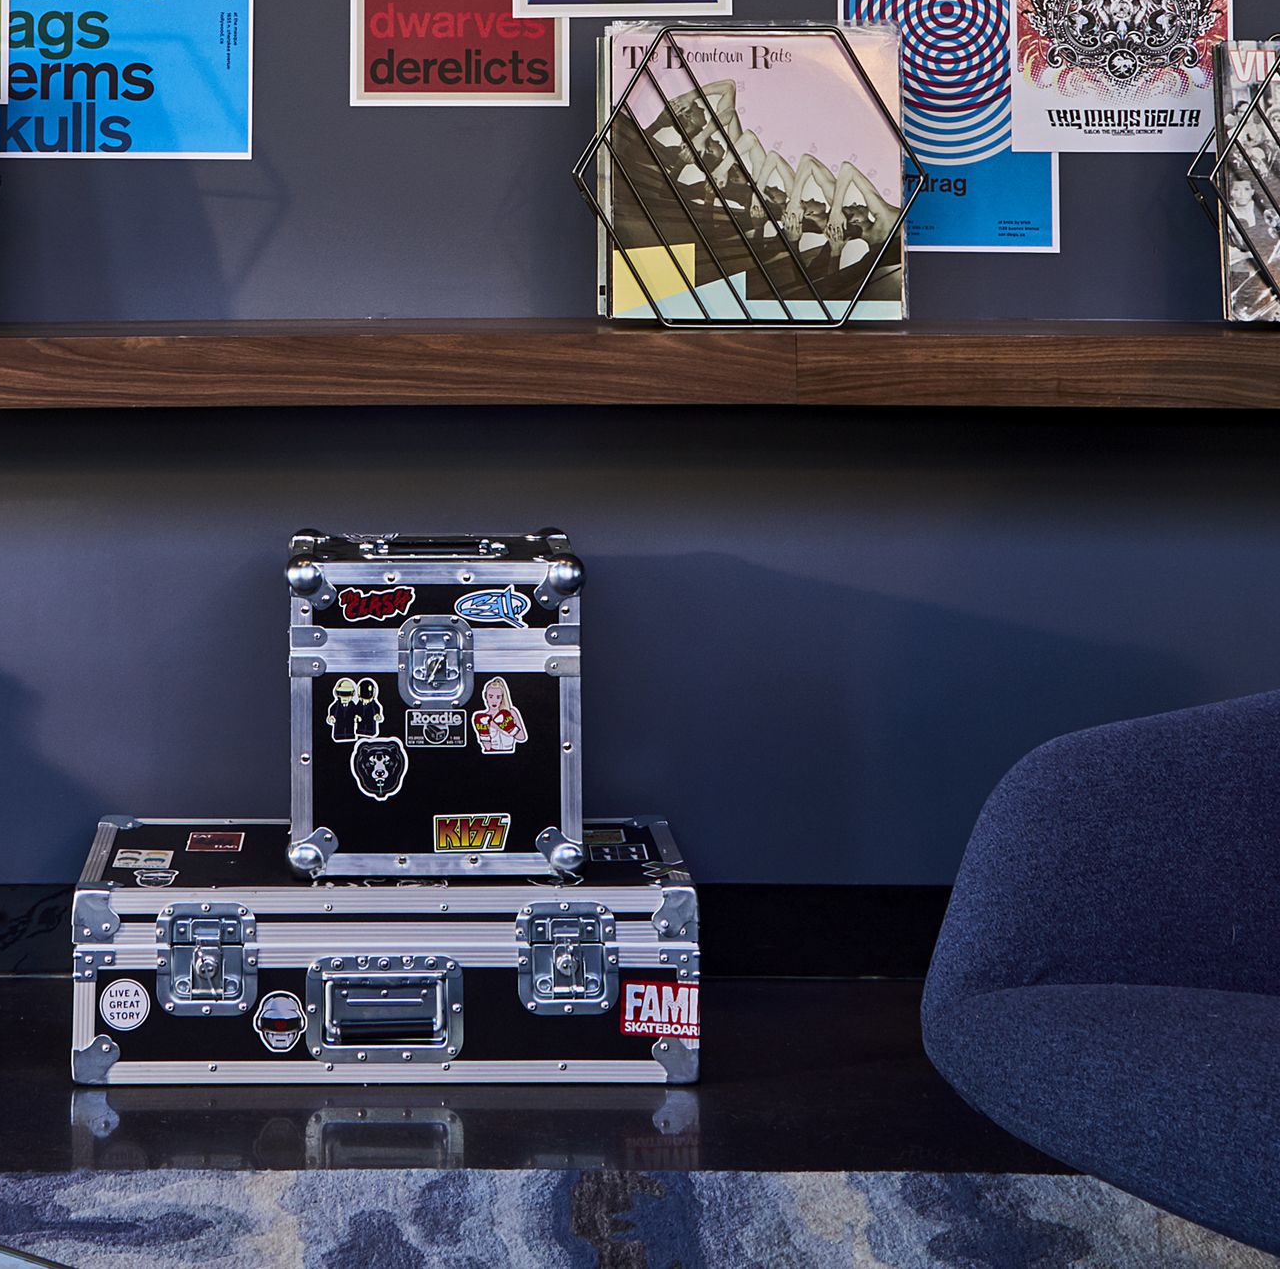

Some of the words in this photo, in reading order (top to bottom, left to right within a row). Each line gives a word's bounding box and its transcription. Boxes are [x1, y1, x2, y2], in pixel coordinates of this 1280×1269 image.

[370, 2, 546, 40] dwarves
[370, 48, 550, 86] derelicts
[748, 45, 793, 70] Rats
[411, 712, 463, 725] Roadie
[436, 814, 510, 849] KISS
[109, 989, 131, 998] LIVE
[133, 990, 140, 998] A
[109, 1000, 141, 1009] GREAT
[624, 983, 699, 1025] FAMI
[109, 1012, 141, 1020] STORY
